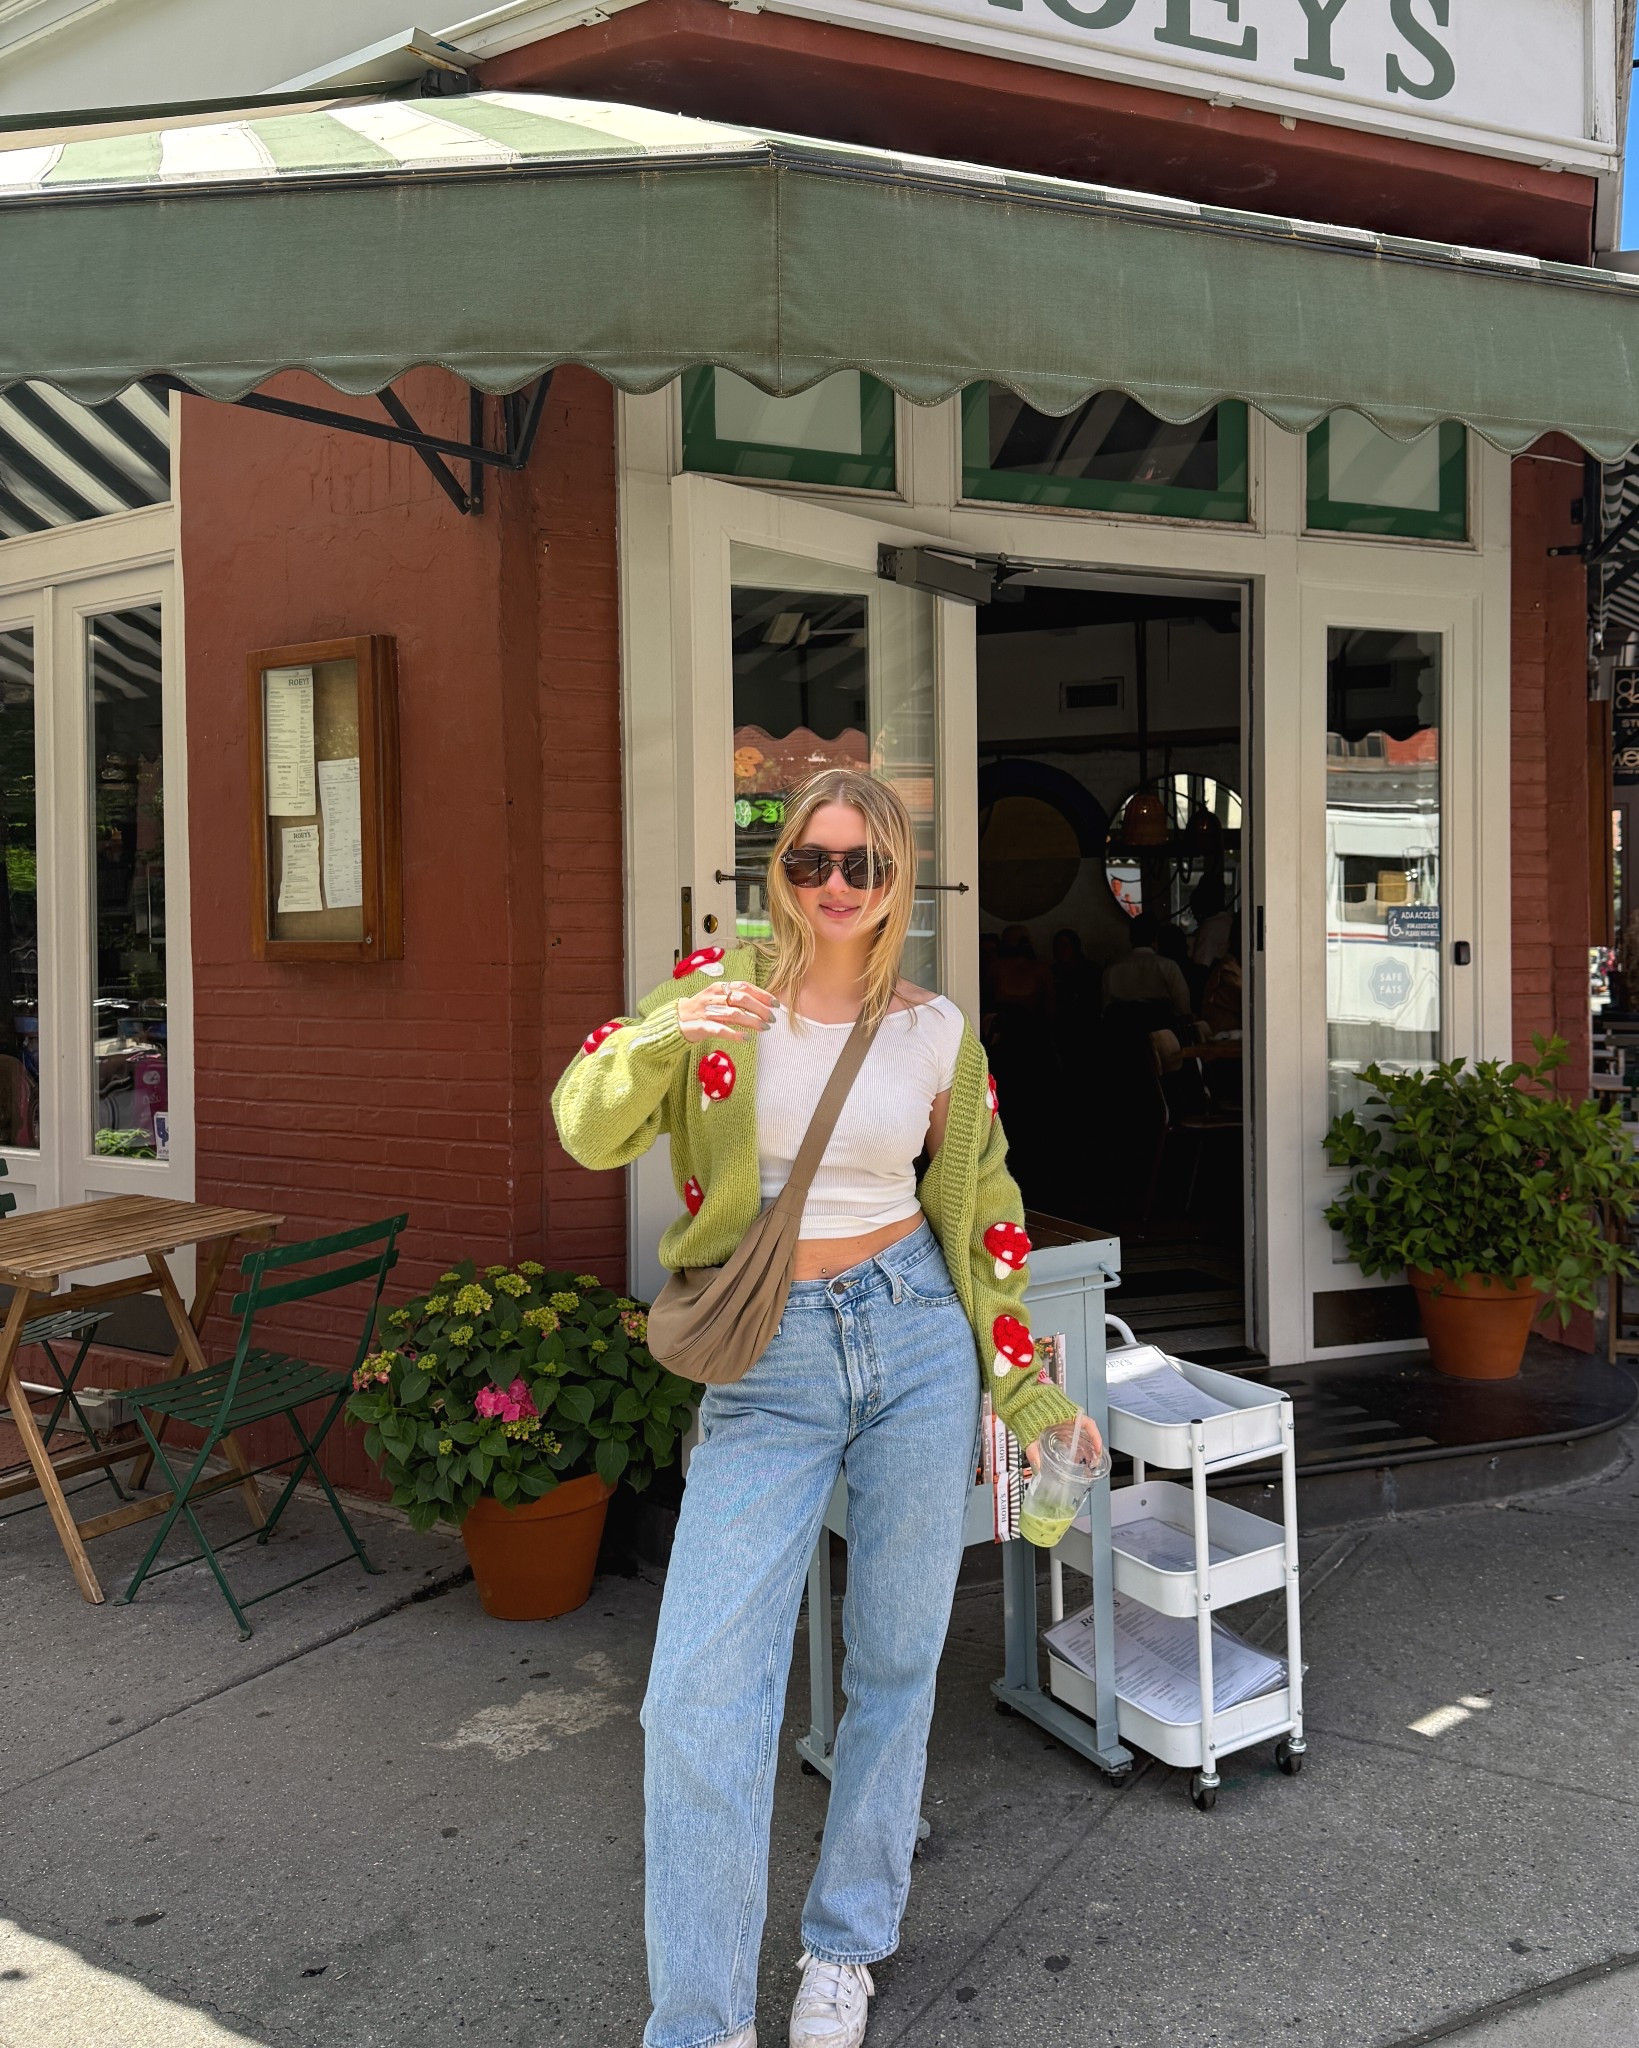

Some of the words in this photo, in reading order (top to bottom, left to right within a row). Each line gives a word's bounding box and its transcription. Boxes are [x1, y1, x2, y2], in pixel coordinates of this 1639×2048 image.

[1401, 911, 1414, 919] ADA
[1414, 911, 1439, 919] ACCESS
[1380, 973, 1402, 982] SAFE
[1380, 985, 1402, 994] EATS
